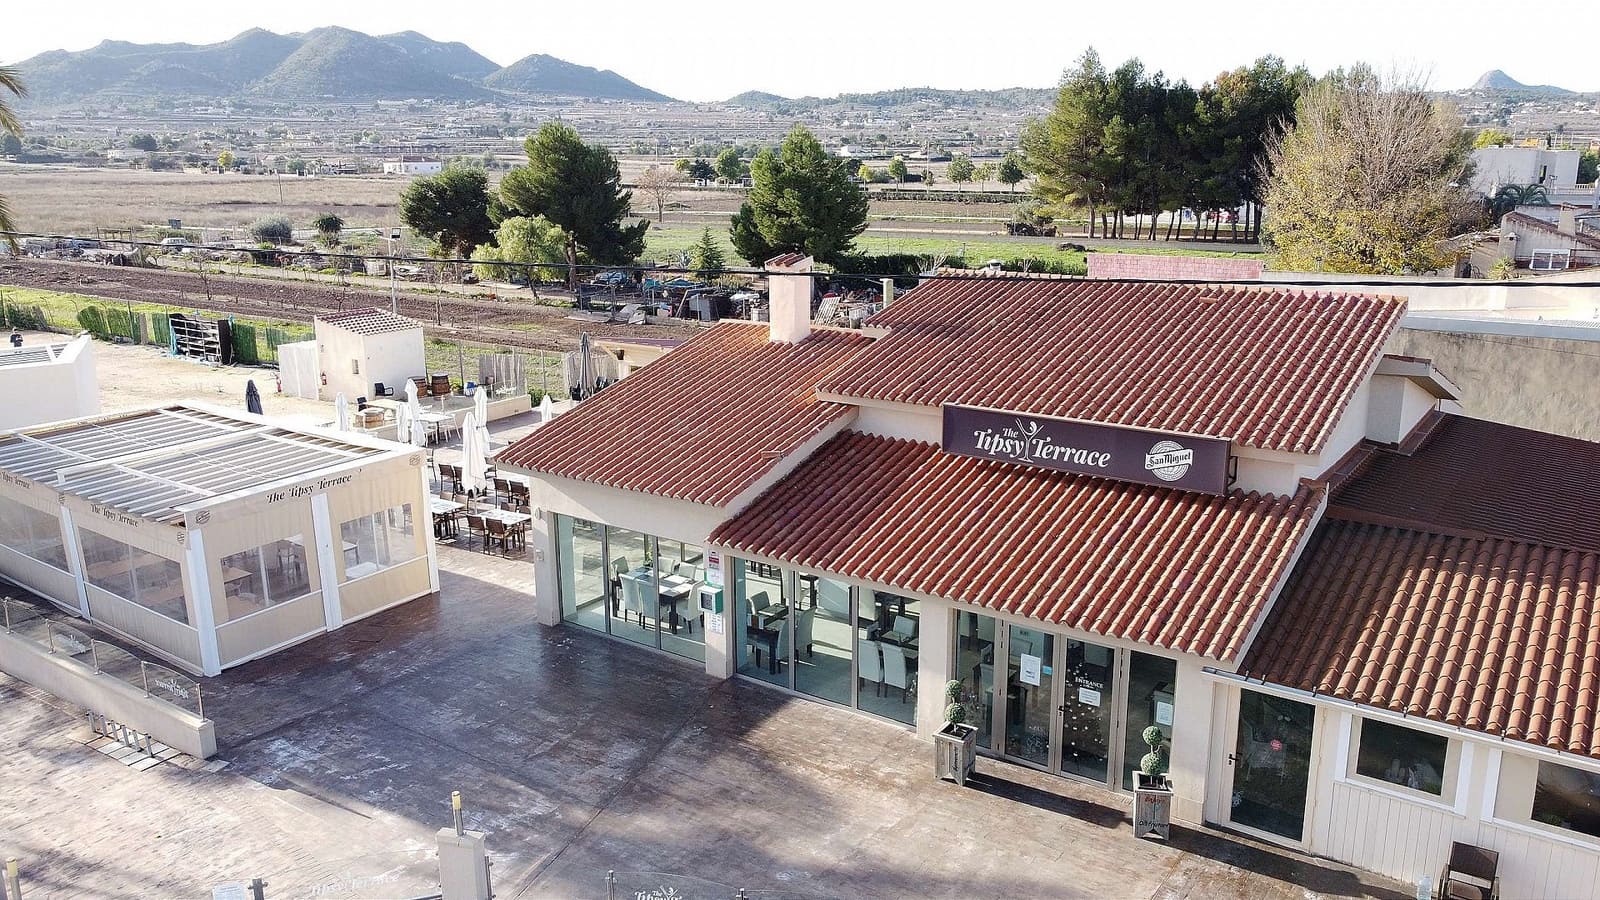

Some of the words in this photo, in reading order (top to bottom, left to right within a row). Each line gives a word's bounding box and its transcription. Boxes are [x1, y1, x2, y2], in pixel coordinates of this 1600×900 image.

[1002, 427, 1019, 438] The
[973, 428, 1025, 458] Tipsy
[1032, 436, 1111, 468] Terrace
[266, 492, 285, 504] The
[288, 485, 314, 498] Tipsy
[317, 475, 352, 490] Terrace
[90, 503, 101, 514] The
[102, 506, 116, 521] Tipsy
[117, 512, 138, 528] Terrace
[1075, 676, 1104, 690] ENTRANCE
